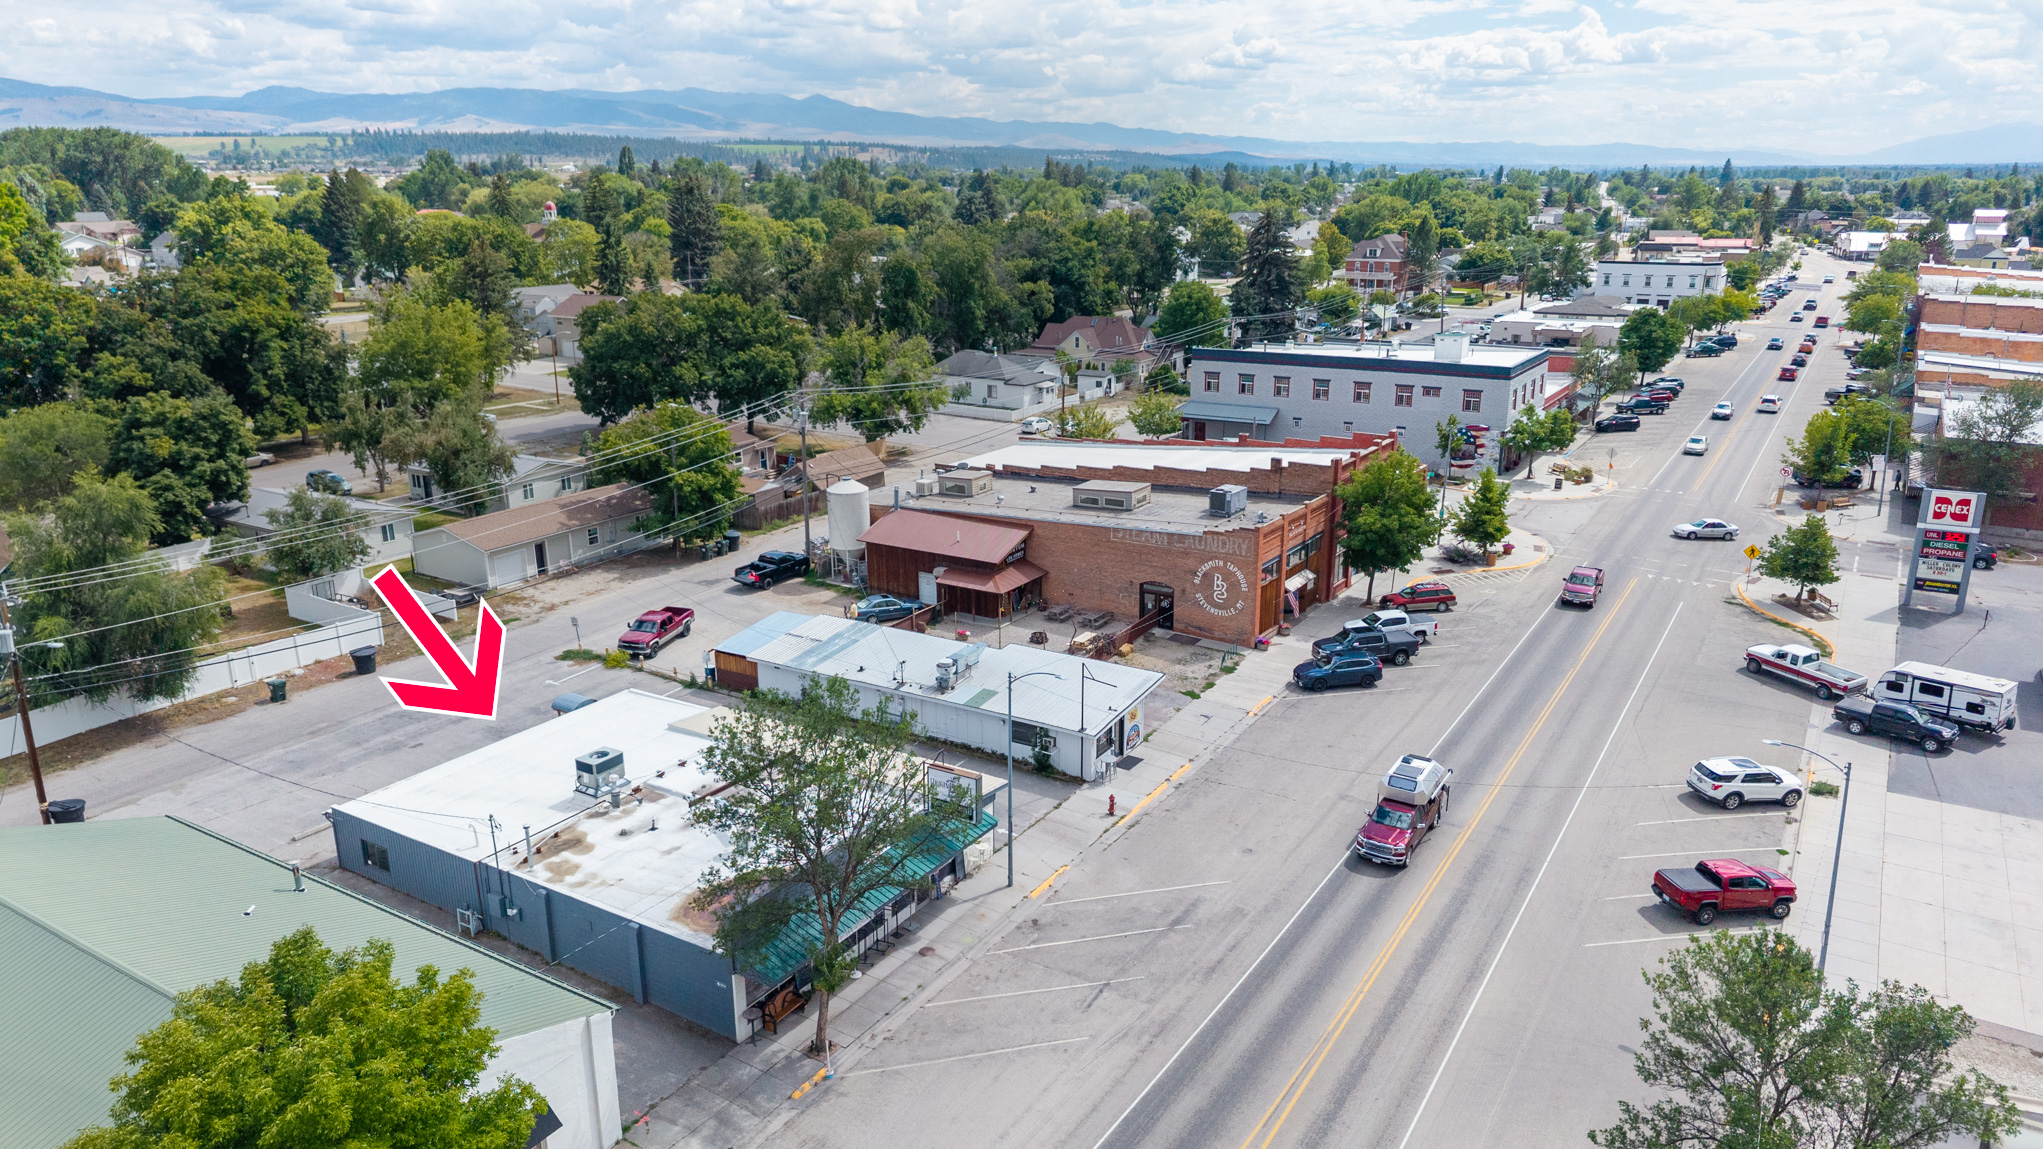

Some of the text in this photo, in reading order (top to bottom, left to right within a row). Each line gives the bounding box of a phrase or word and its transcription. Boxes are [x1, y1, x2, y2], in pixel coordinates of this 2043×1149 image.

[1935, 503, 1969, 514] CENEX
[1926, 531, 1939, 539] UNL
[1930, 541, 1960, 550] DIESEL
[1923, 548, 1964, 557] PROPANE
[1193, 560, 1249, 592] BLACKSMITH TAPHOUSE
[1195, 592, 1245, 616] STEVENSVILLE, MT
